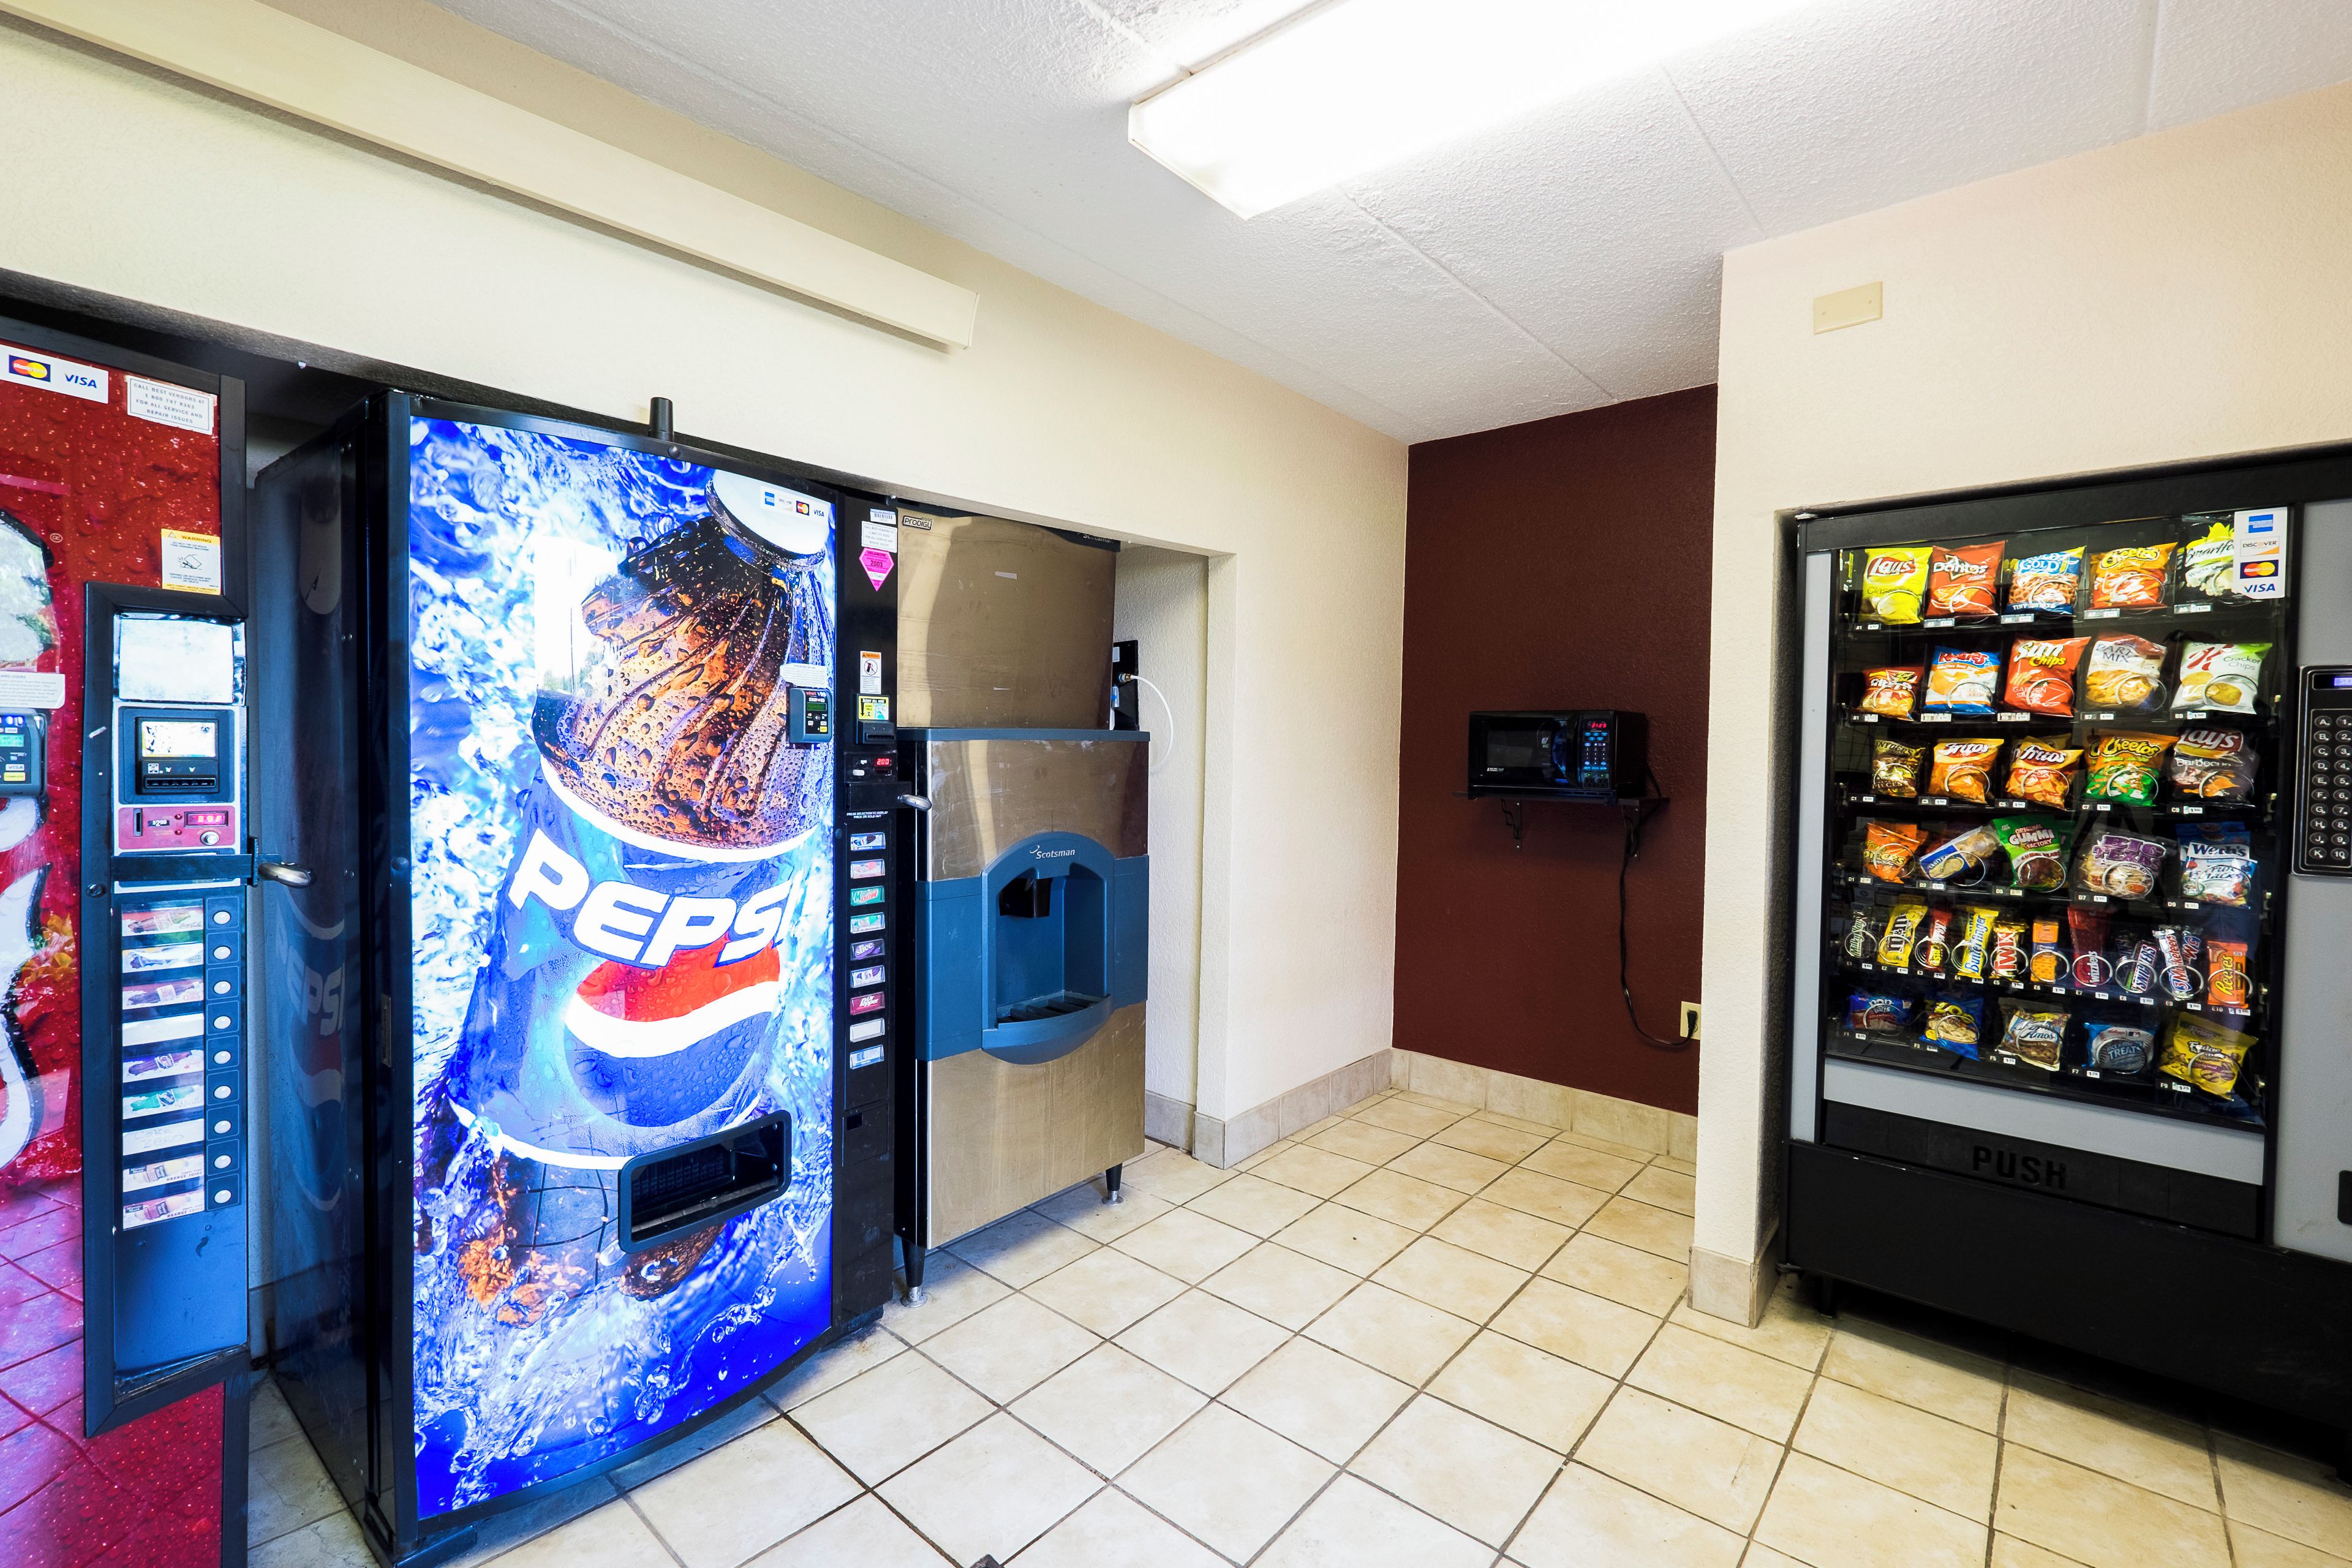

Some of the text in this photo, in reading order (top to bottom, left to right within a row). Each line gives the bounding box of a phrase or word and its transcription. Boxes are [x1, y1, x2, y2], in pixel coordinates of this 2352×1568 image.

[64, 372, 98, 389] VISA
[168, 391, 197, 402] VENDORS
[146, 409, 194, 424] REPAIR ISSUES
[164, 405, 189, 415] SERVICE
[2101, 547, 2159, 568] Cheetos
[2186, 540, 2234, 564] Smartfo
[1933, 557, 1989, 575] Doritos
[2019, 560, 2060, 573] GOLD
[2244, 583, 2275, 594] VISA
[2013, 641, 2064, 663] Sun
[2103, 652, 2129, 663] MIX
[2029, 655, 2067, 668] Chips
[2223, 655, 2262, 664] Cracker
[2228, 662, 2256, 671] Chips
[1937, 742, 1990, 756] Fritos
[2102, 736, 2161, 756] Cheetos
[2019, 744, 2067, 763] Fritos
[2015, 824, 2043, 834] ORIGINAL
[2009, 829, 2055, 845] GUMMI
[2026, 839, 2052, 849] FACTORY
[2101, 834, 2167, 859] BIG
[1036, 849, 1076, 859] Scotsman
[856, 943, 873, 956] slice
[1964, 914, 1989, 974] Butterfinger
[1994, 931, 2018, 971] TWIX
[2215, 953, 2234, 997] Reese's
[2019, 1031, 2053, 1040] Amos
[2108, 1046, 2142, 1060] TREATS
[1972, 1145, 2067, 1190] PUSH
